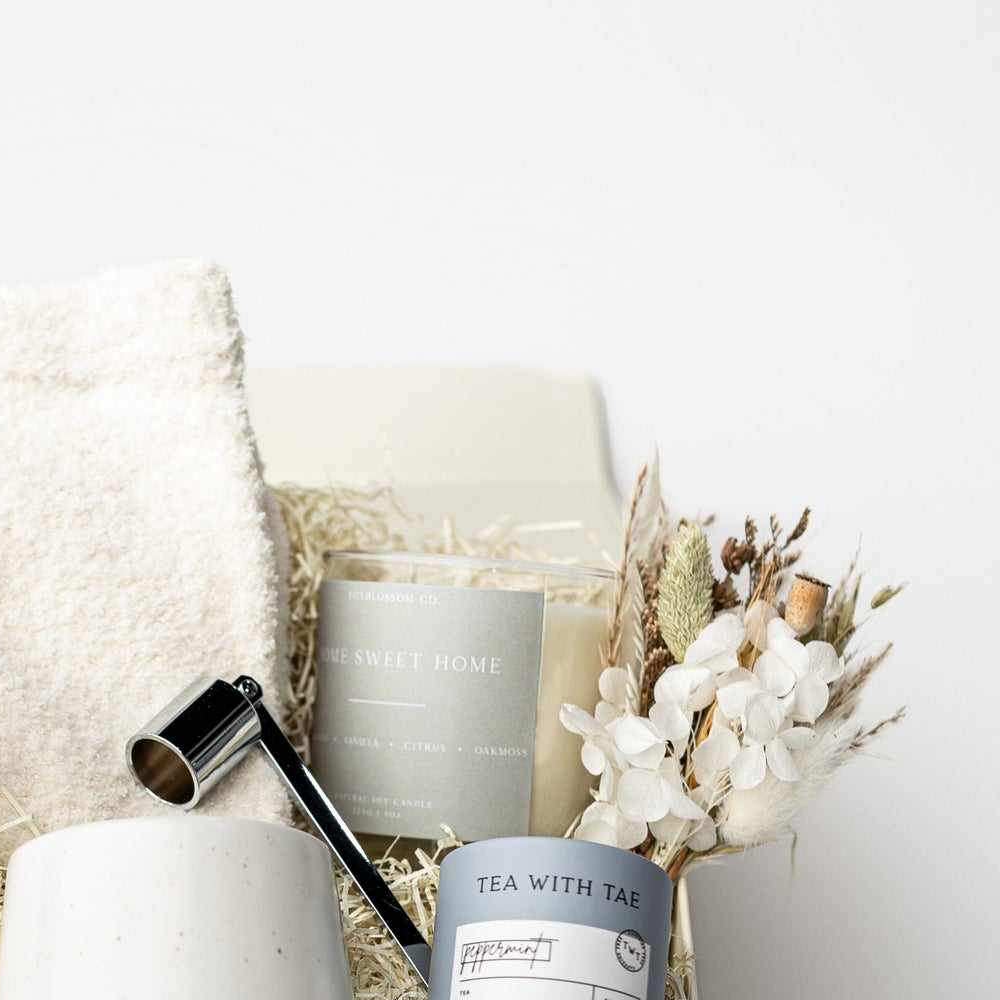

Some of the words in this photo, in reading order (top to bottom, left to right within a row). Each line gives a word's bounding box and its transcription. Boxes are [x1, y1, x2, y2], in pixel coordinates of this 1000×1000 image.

[348, 591, 414, 604] FOXBLOSSOM
[419, 594, 440, 606] CO.
[319, 647, 348, 665] OME
[354, 650, 423, 670] SWEET
[434, 654, 502, 674] HOME
[403, 742, 447, 753] CITRUS
[473, 746, 528, 757] OAKMOSS
[372, 797, 388, 806] SOY
[393, 798, 433, 810] CANDLE
[477, 875, 518, 894] TEA
[529, 875, 593, 896] WITH
[603, 883, 641, 910] TAE
[460, 932, 560, 975] peppermint
